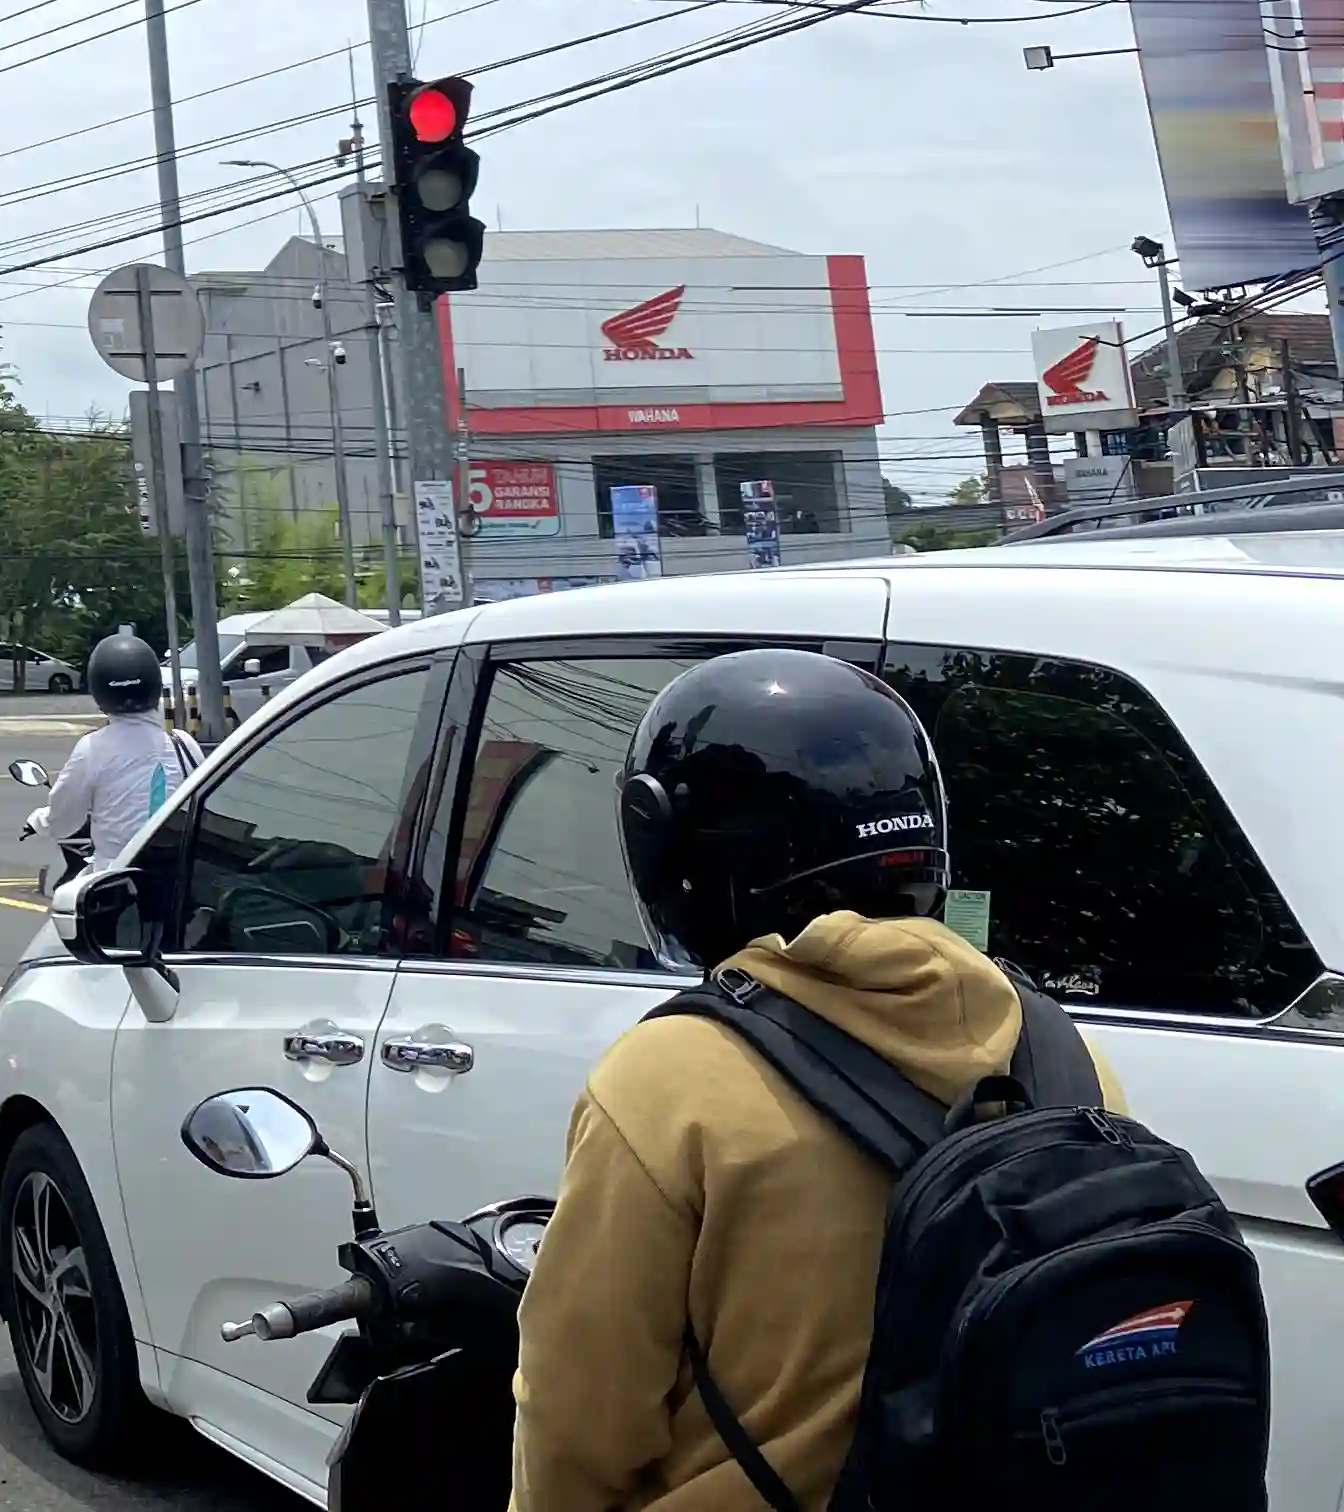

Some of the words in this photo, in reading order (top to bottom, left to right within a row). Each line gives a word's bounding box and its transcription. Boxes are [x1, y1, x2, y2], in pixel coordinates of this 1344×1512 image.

[602, 347, 694, 361] HONDA
[628, 408, 679, 423] WAHANA
[469, 469, 493, 512] 5
[855, 814, 935, 838] HONDA
[1084, 1346, 1147, 1368] KERETA
[1152, 1341, 1177, 1357] API
